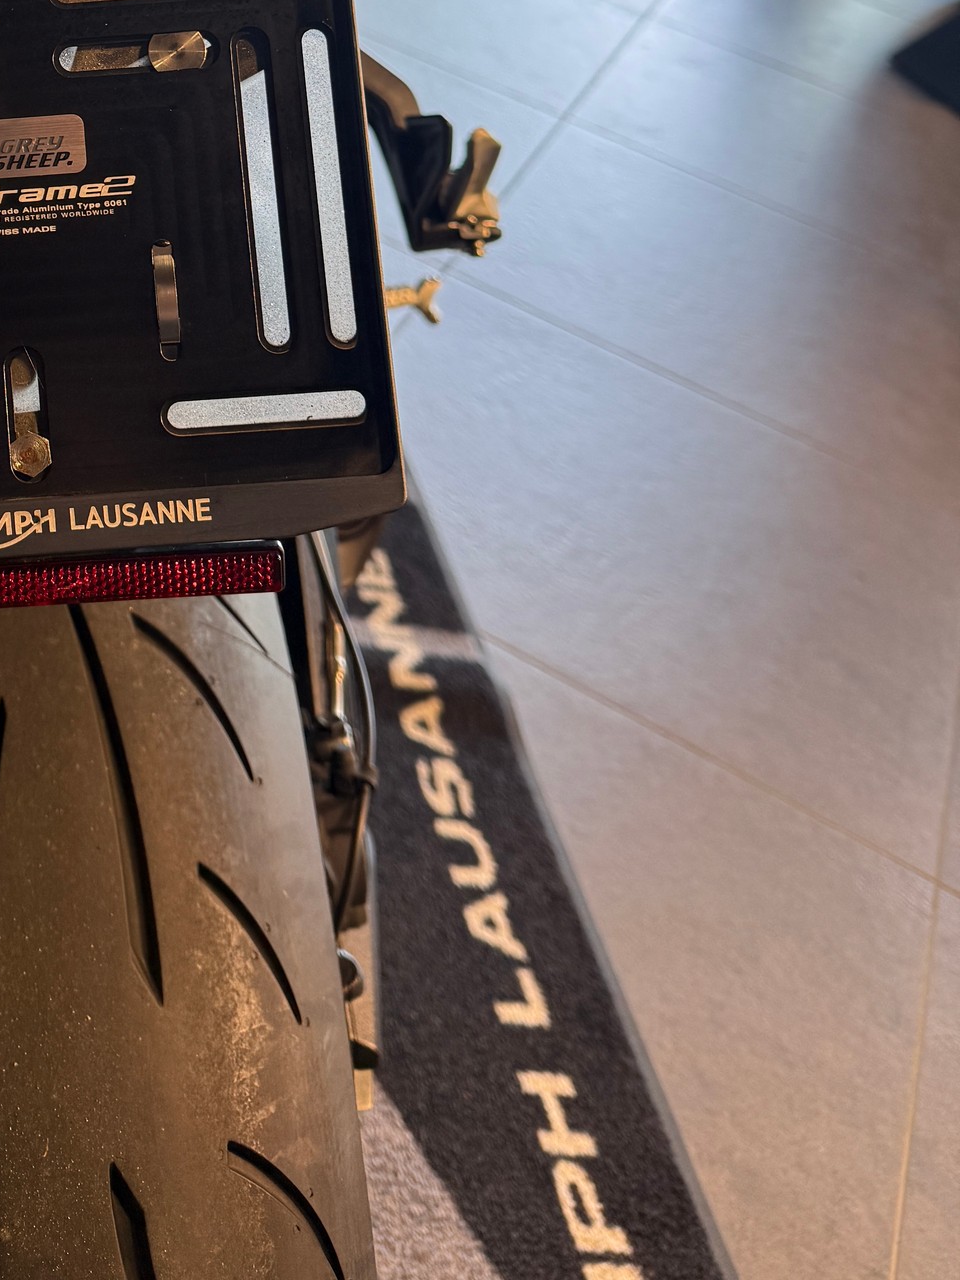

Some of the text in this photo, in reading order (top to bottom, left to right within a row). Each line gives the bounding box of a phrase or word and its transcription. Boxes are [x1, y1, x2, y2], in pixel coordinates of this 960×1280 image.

[22, 203, 74, 214] Aluminium
[77, 201, 101, 210] Type
[104, 199, 128, 207] 6061
[4, 213, 58, 222] REGISTERED
[61, 209, 115, 218] WORLDWIDE
[22, 225, 57, 234] MADE
[70, 498, 212, 530] LAUSANNE
[355, 547, 644, 1280] PH LAUSANNE
